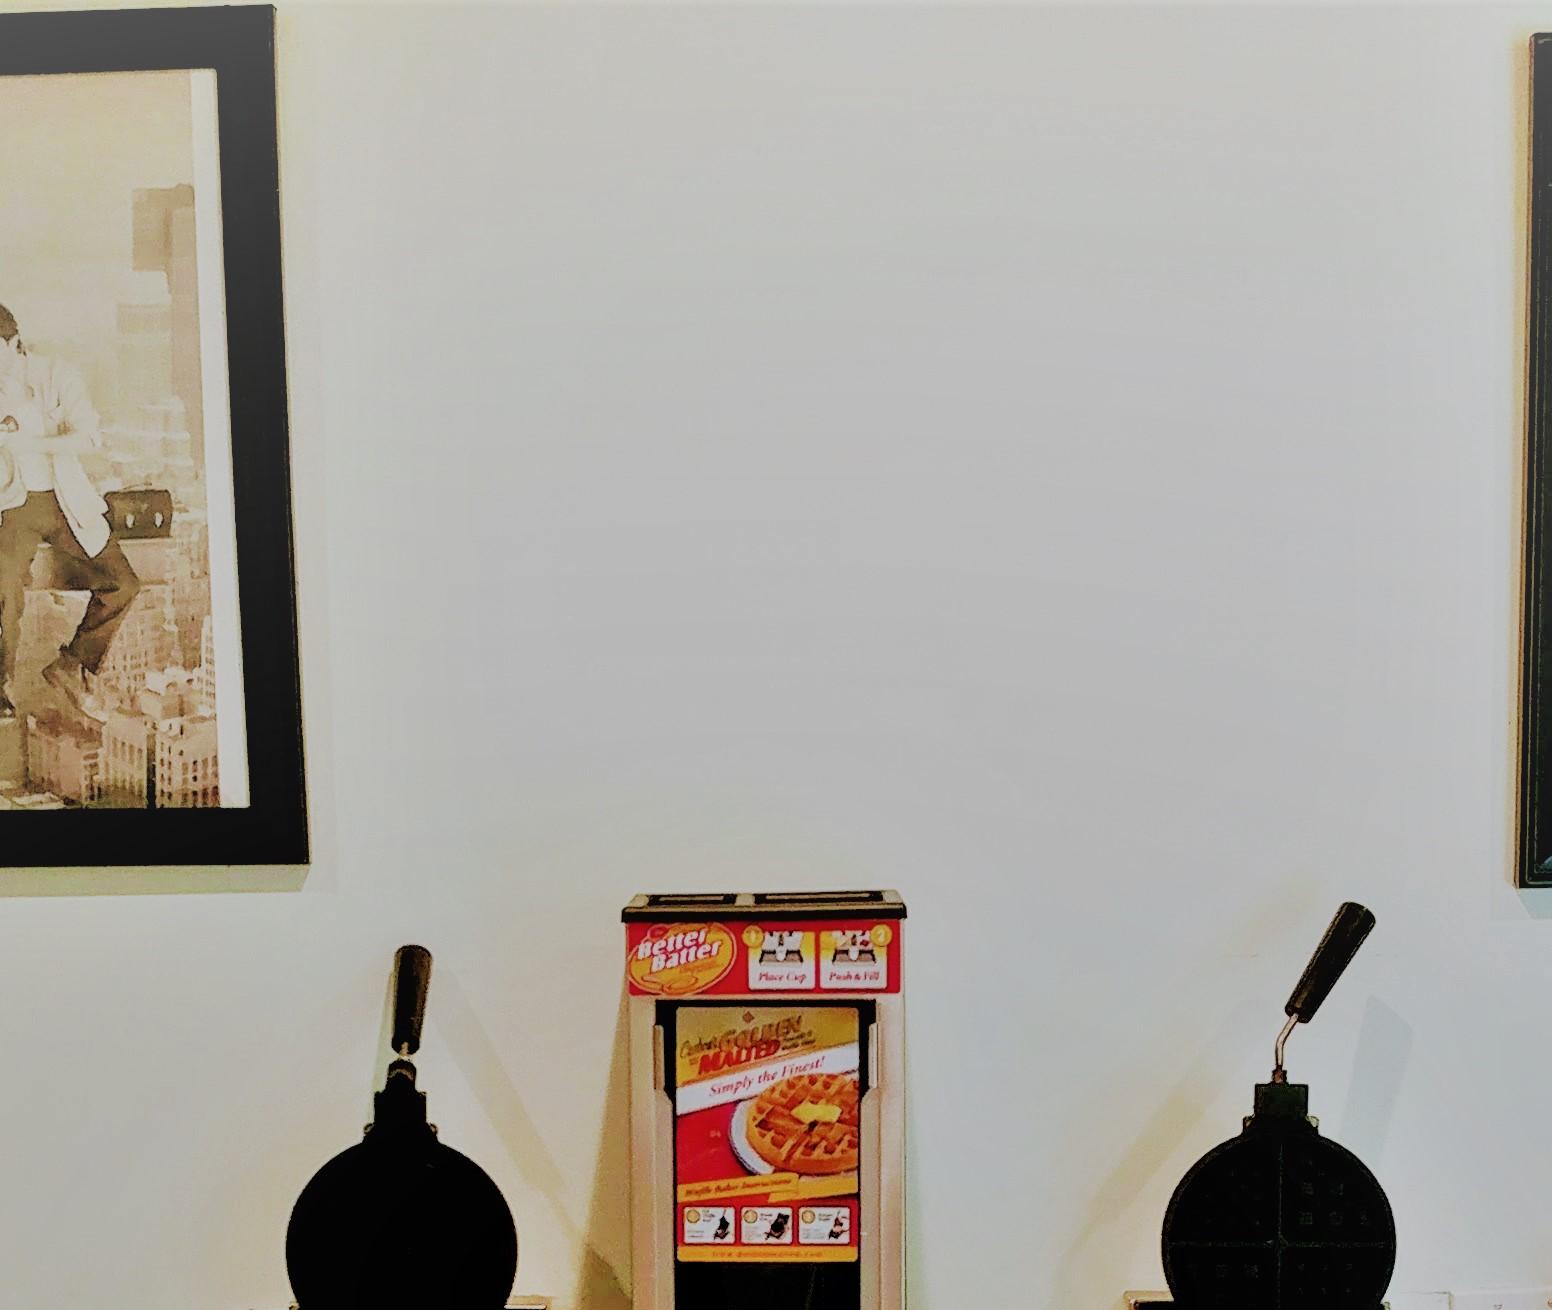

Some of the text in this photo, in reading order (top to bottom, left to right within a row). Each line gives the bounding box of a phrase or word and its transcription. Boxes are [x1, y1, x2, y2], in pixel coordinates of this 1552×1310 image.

[709, 1055, 827, 1097] Simply the Finest!
